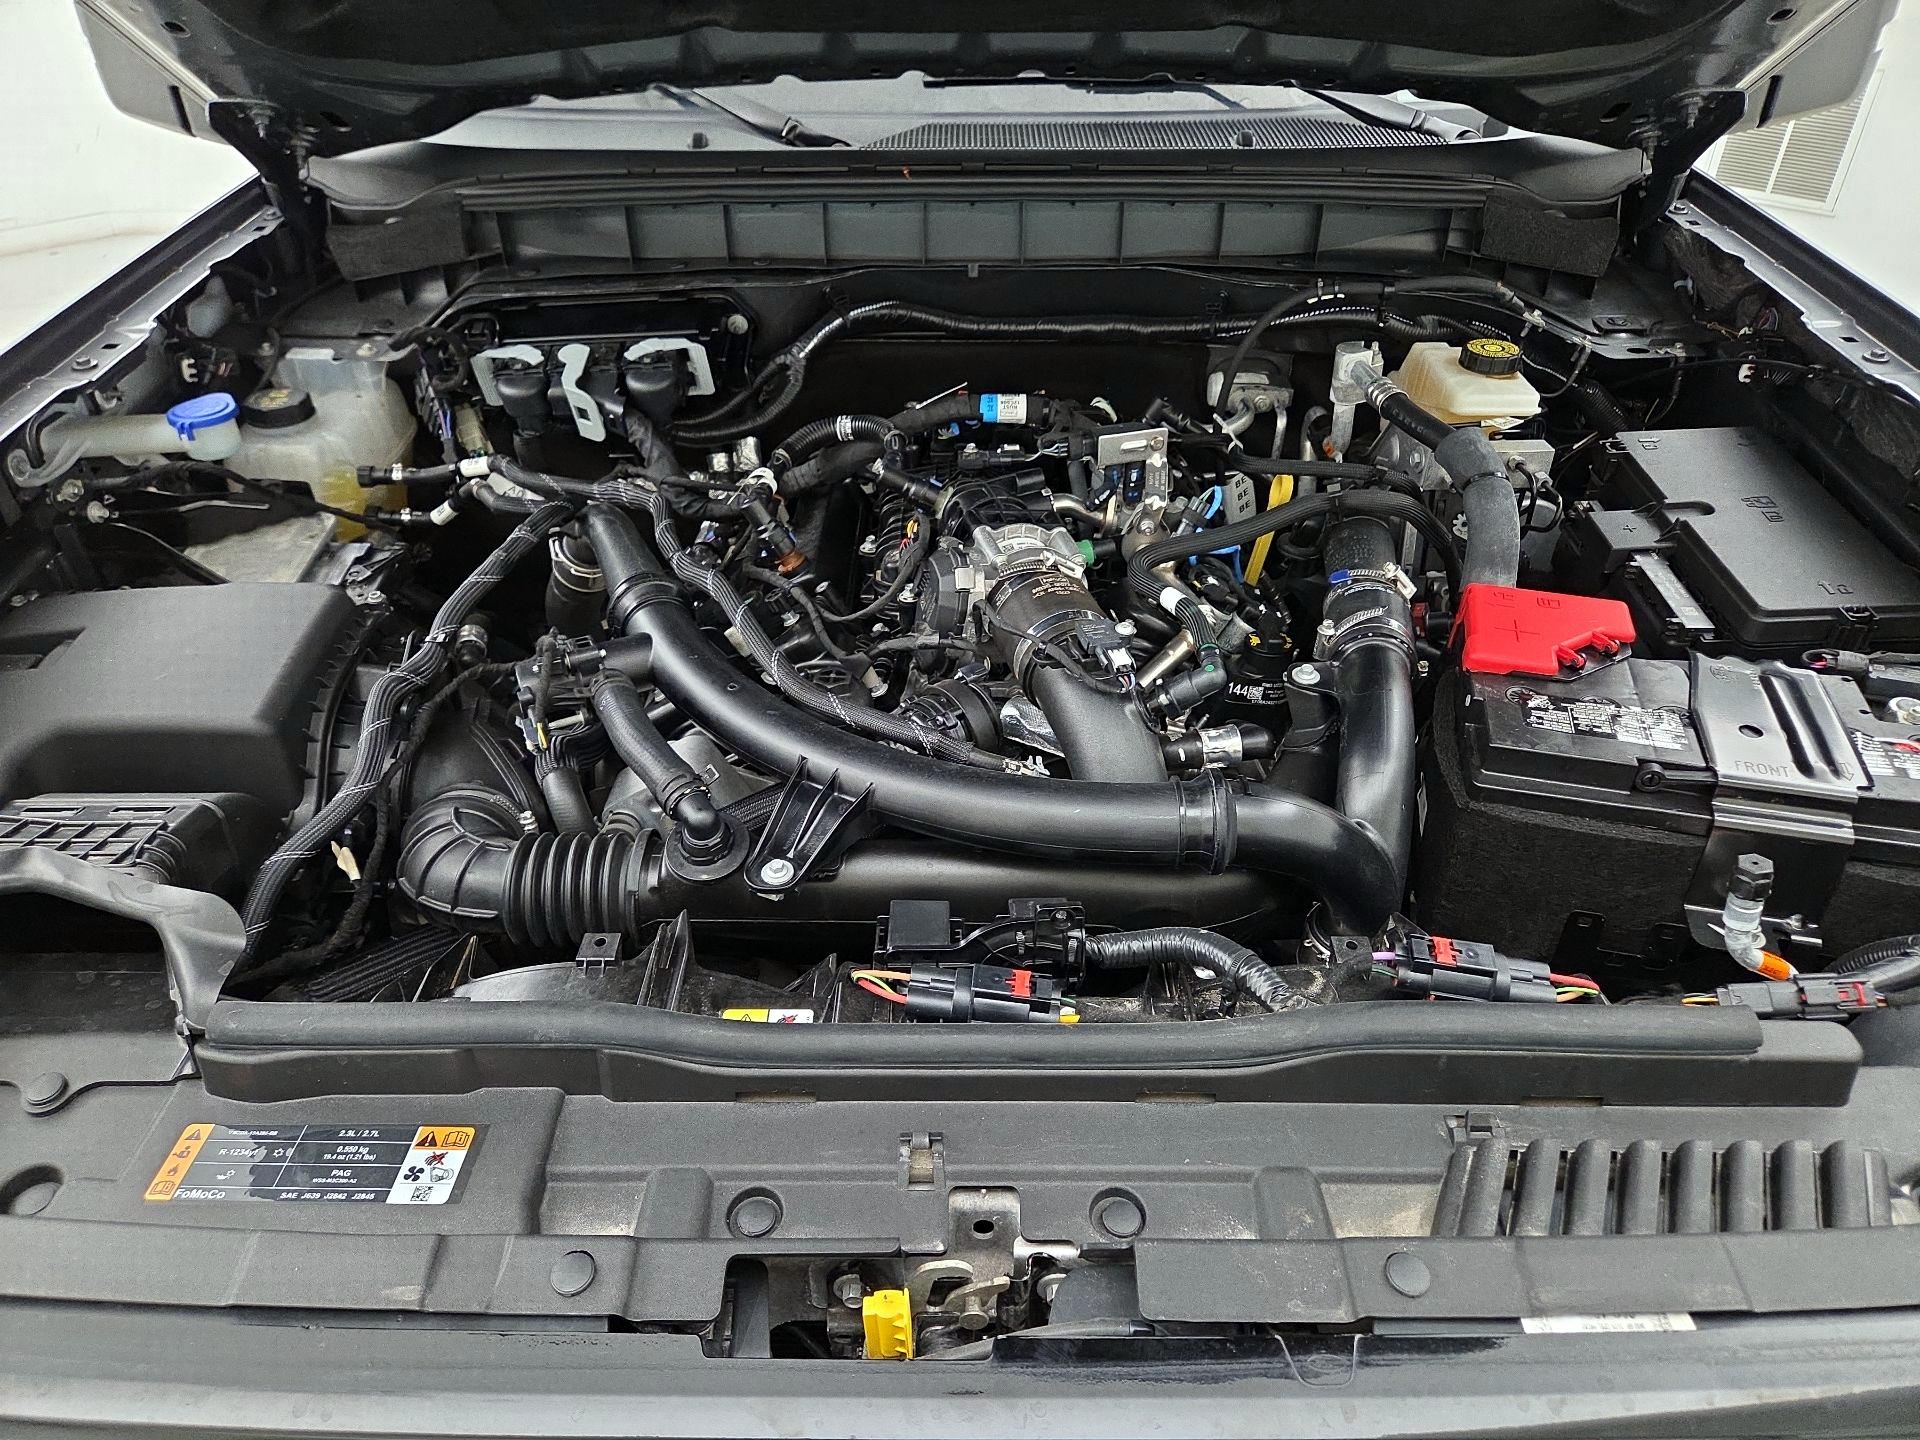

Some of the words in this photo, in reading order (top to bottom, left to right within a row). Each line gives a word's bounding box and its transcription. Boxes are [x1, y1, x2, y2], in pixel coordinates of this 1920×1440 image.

[1235, 475, 1247, 489] BE
[1237, 487, 1249, 501] BE
[1239, 500, 1251, 513] BE
[1228, 681, 1248, 698] 144
[1734, 760, 1789, 778] FRONT
[338, 1129, 356, 1137] 2.3L
[218, 1148, 259, 1160] R-1234yf
[336, 1145, 358, 1153] 0.550
[358, 1146, 370, 1154] kg
[331, 1169, 352, 1177] PAG
[174, 1188, 226, 1200] FoMoCo
[301, 1192, 321, 1200] J639
